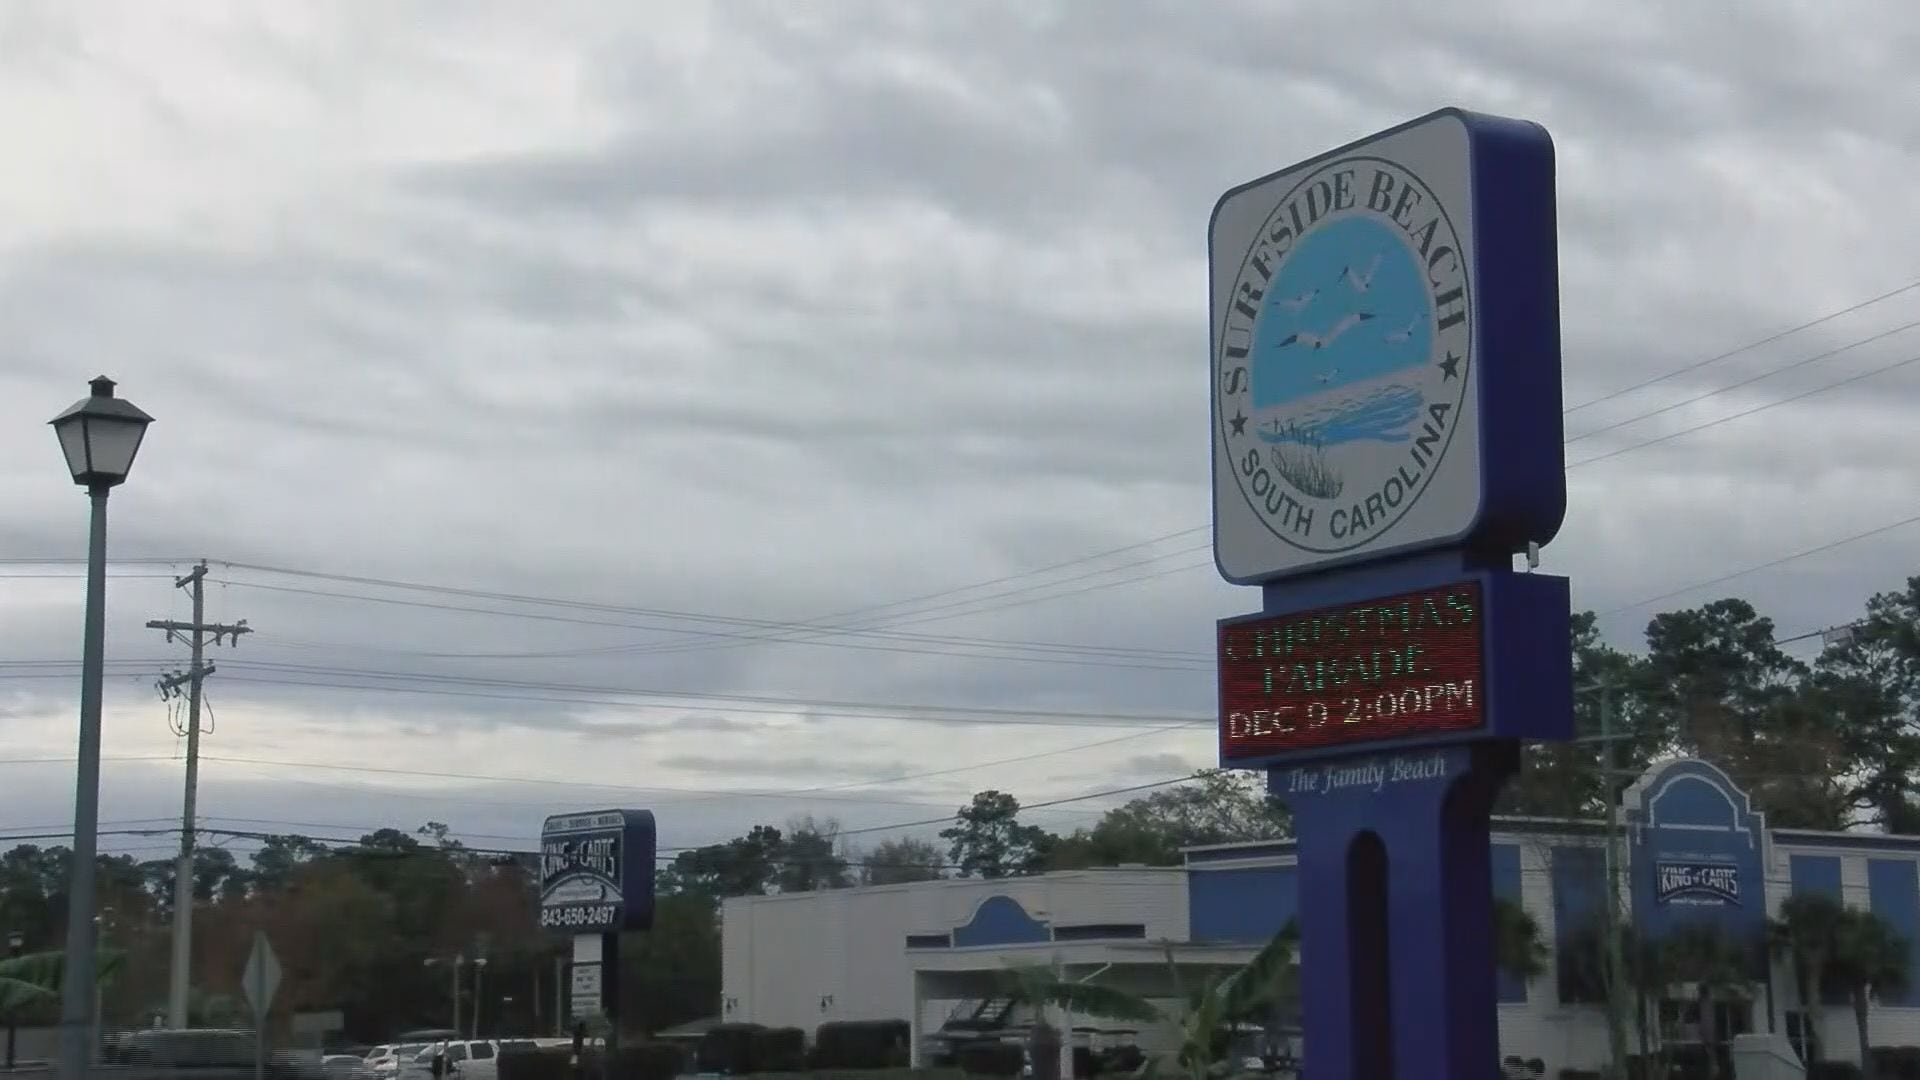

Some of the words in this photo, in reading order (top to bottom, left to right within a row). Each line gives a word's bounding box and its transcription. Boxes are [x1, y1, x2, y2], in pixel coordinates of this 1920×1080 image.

[1223, 169, 1356, 396] SURFSIDE
[1366, 169, 1466, 336] BEACH
[1241, 448, 1315, 537] SOUTH
[1329, 401, 1452, 539] CAROLINA
[1226, 593, 1473, 661] CHRISTMAS
[1229, 706, 1297, 738] DEC
[1307, 702, 1328, 728] 9
[1341, 679, 1473, 724] 2:00PM
[1288, 768, 1317, 793] The
[1391, 754, 1448, 783] Beach
[540, 841, 570, 879] KING
[579, 837, 615, 879] CARTS
[1661, 866, 1692, 894] KING
[1701, 868, 1737, 895] CARTS
[541, 905, 616, 928] 843-650-2497
